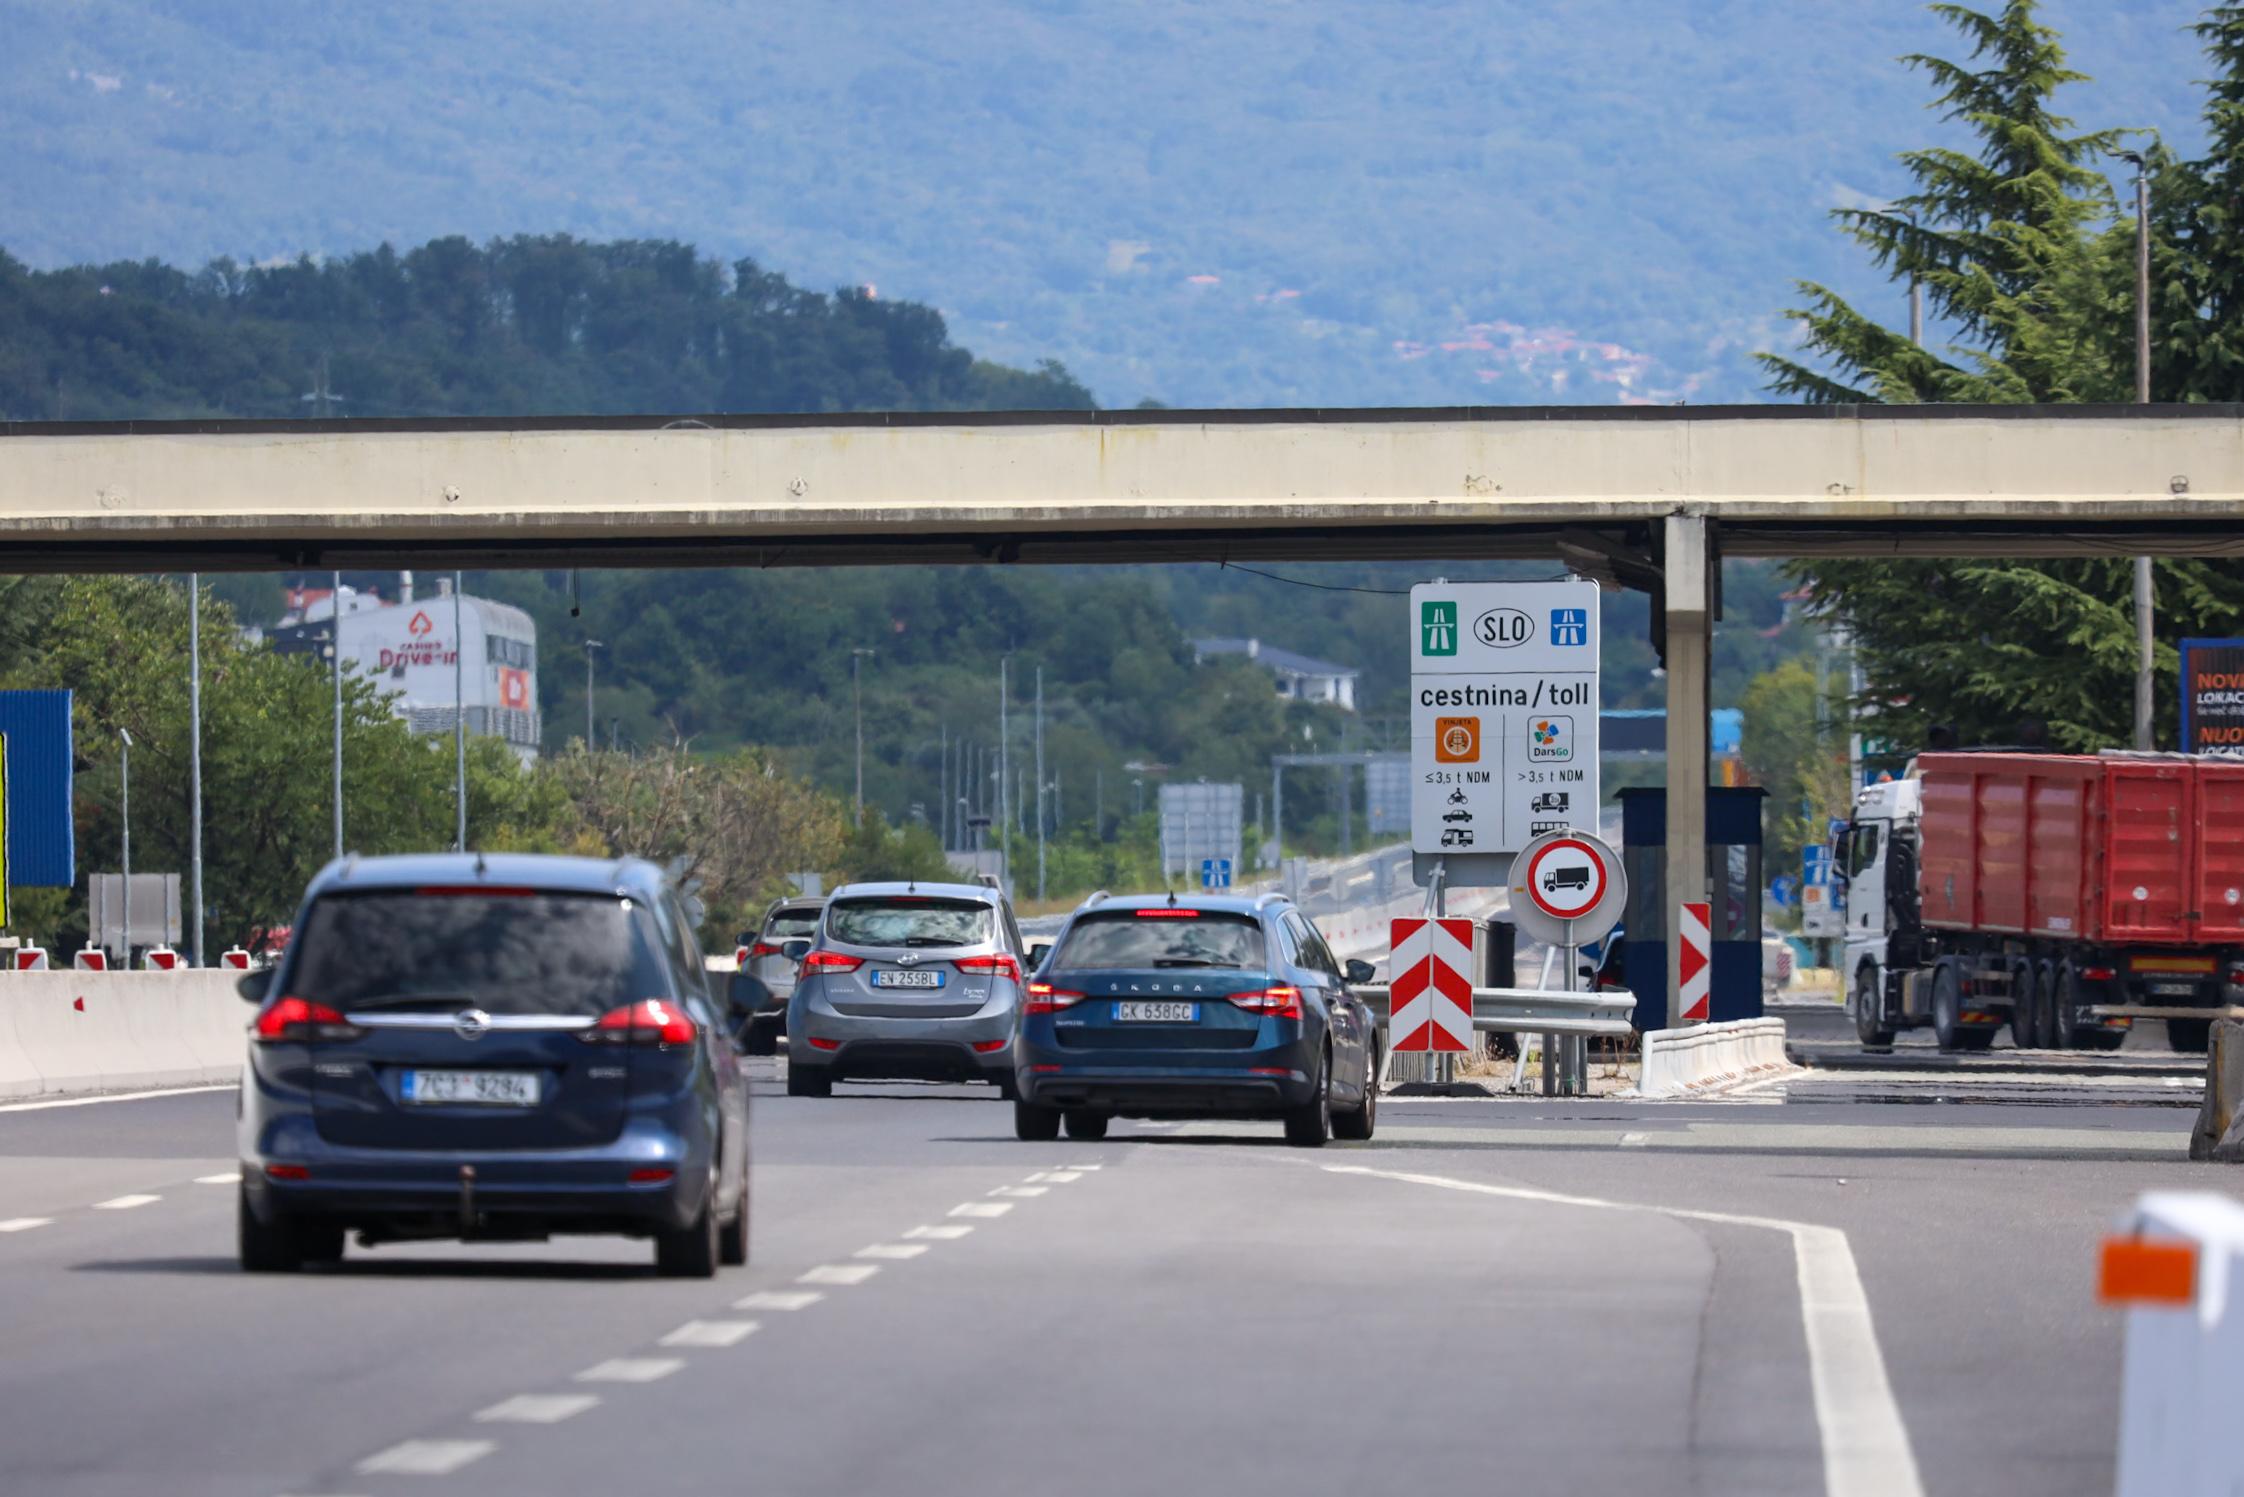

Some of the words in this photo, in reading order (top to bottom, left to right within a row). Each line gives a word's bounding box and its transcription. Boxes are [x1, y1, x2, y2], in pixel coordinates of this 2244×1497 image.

[1484, 616, 1525, 642] SLO
[1534, 747, 1569, 757] DarsGo
[1467, 771, 1490, 783] NDM
[1559, 770, 1583, 782] NDM
